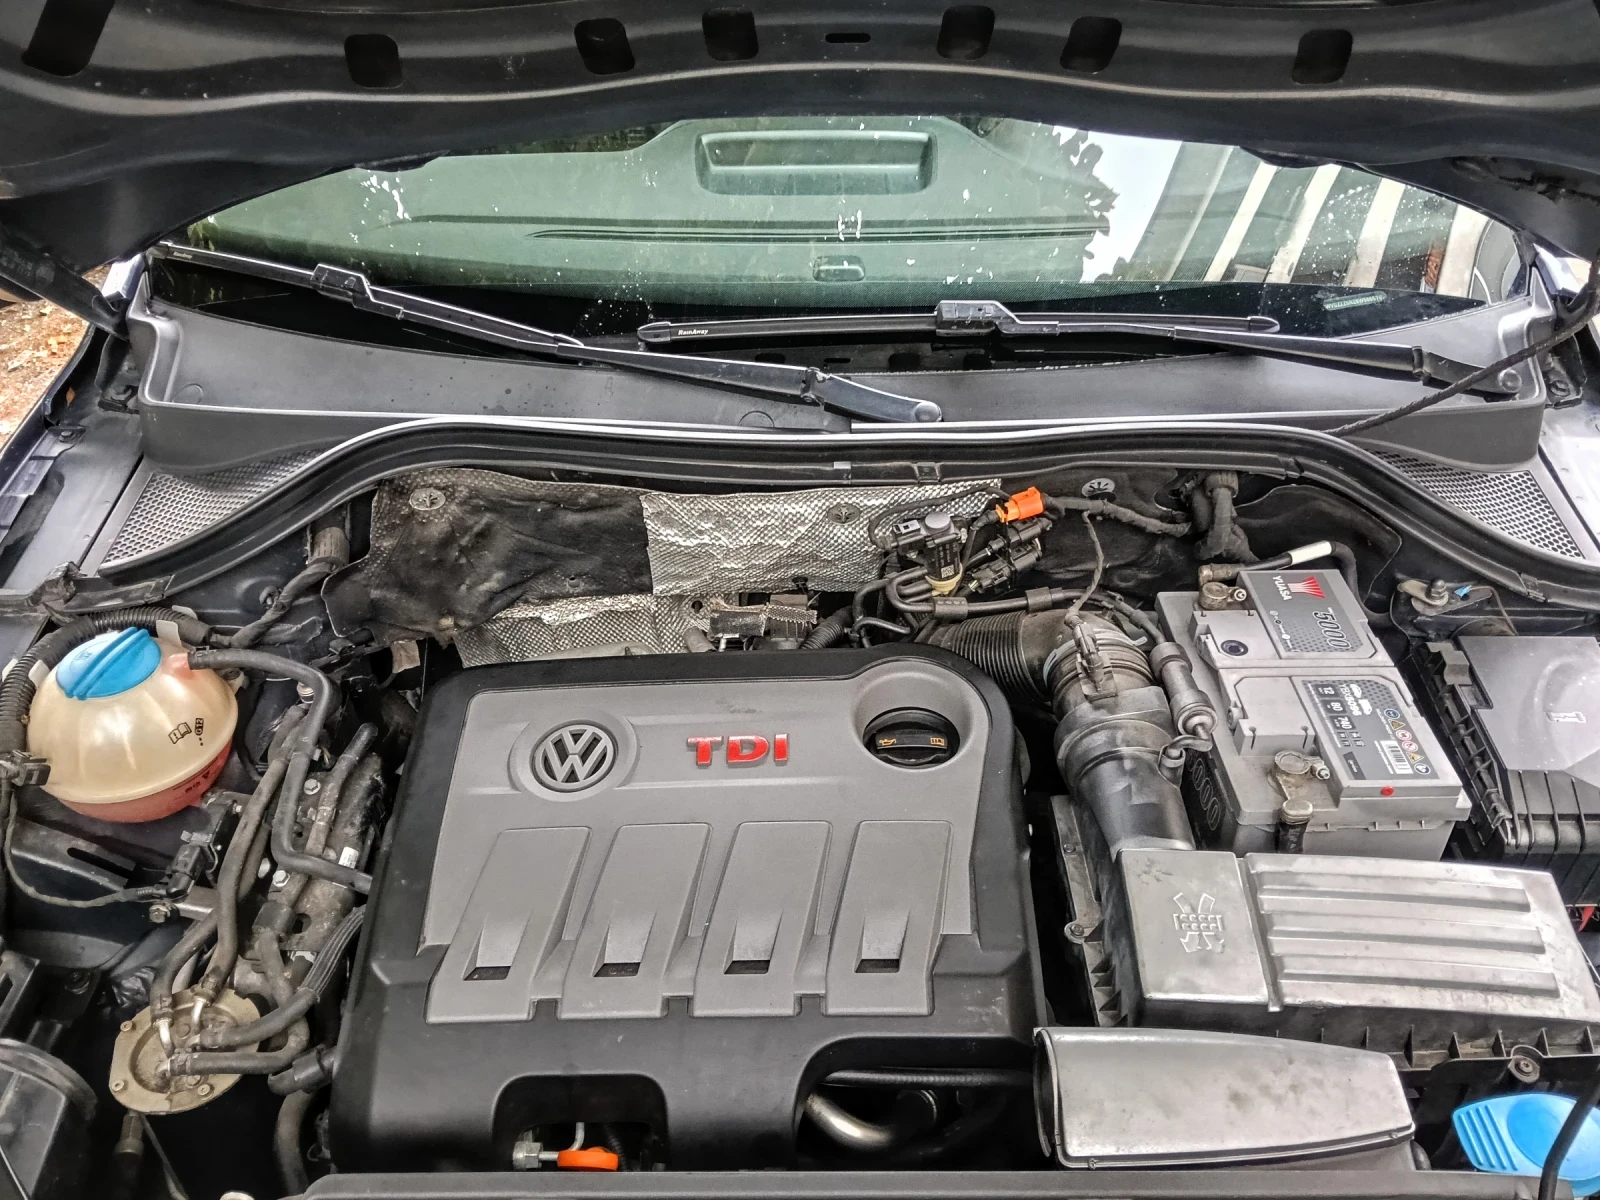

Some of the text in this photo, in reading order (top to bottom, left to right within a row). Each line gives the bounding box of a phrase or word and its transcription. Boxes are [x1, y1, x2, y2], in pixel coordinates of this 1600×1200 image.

[1272, 575, 1292, 600] YUASA
[1312, 611, 1352, 649] 5000
[1323, 686, 1335, 695] 12
[1331, 702, 1343, 712] 80
[195, 718, 204, 735] G12
[1338, 716, 1352, 730] 740
[686, 733, 789, 768] TDI
